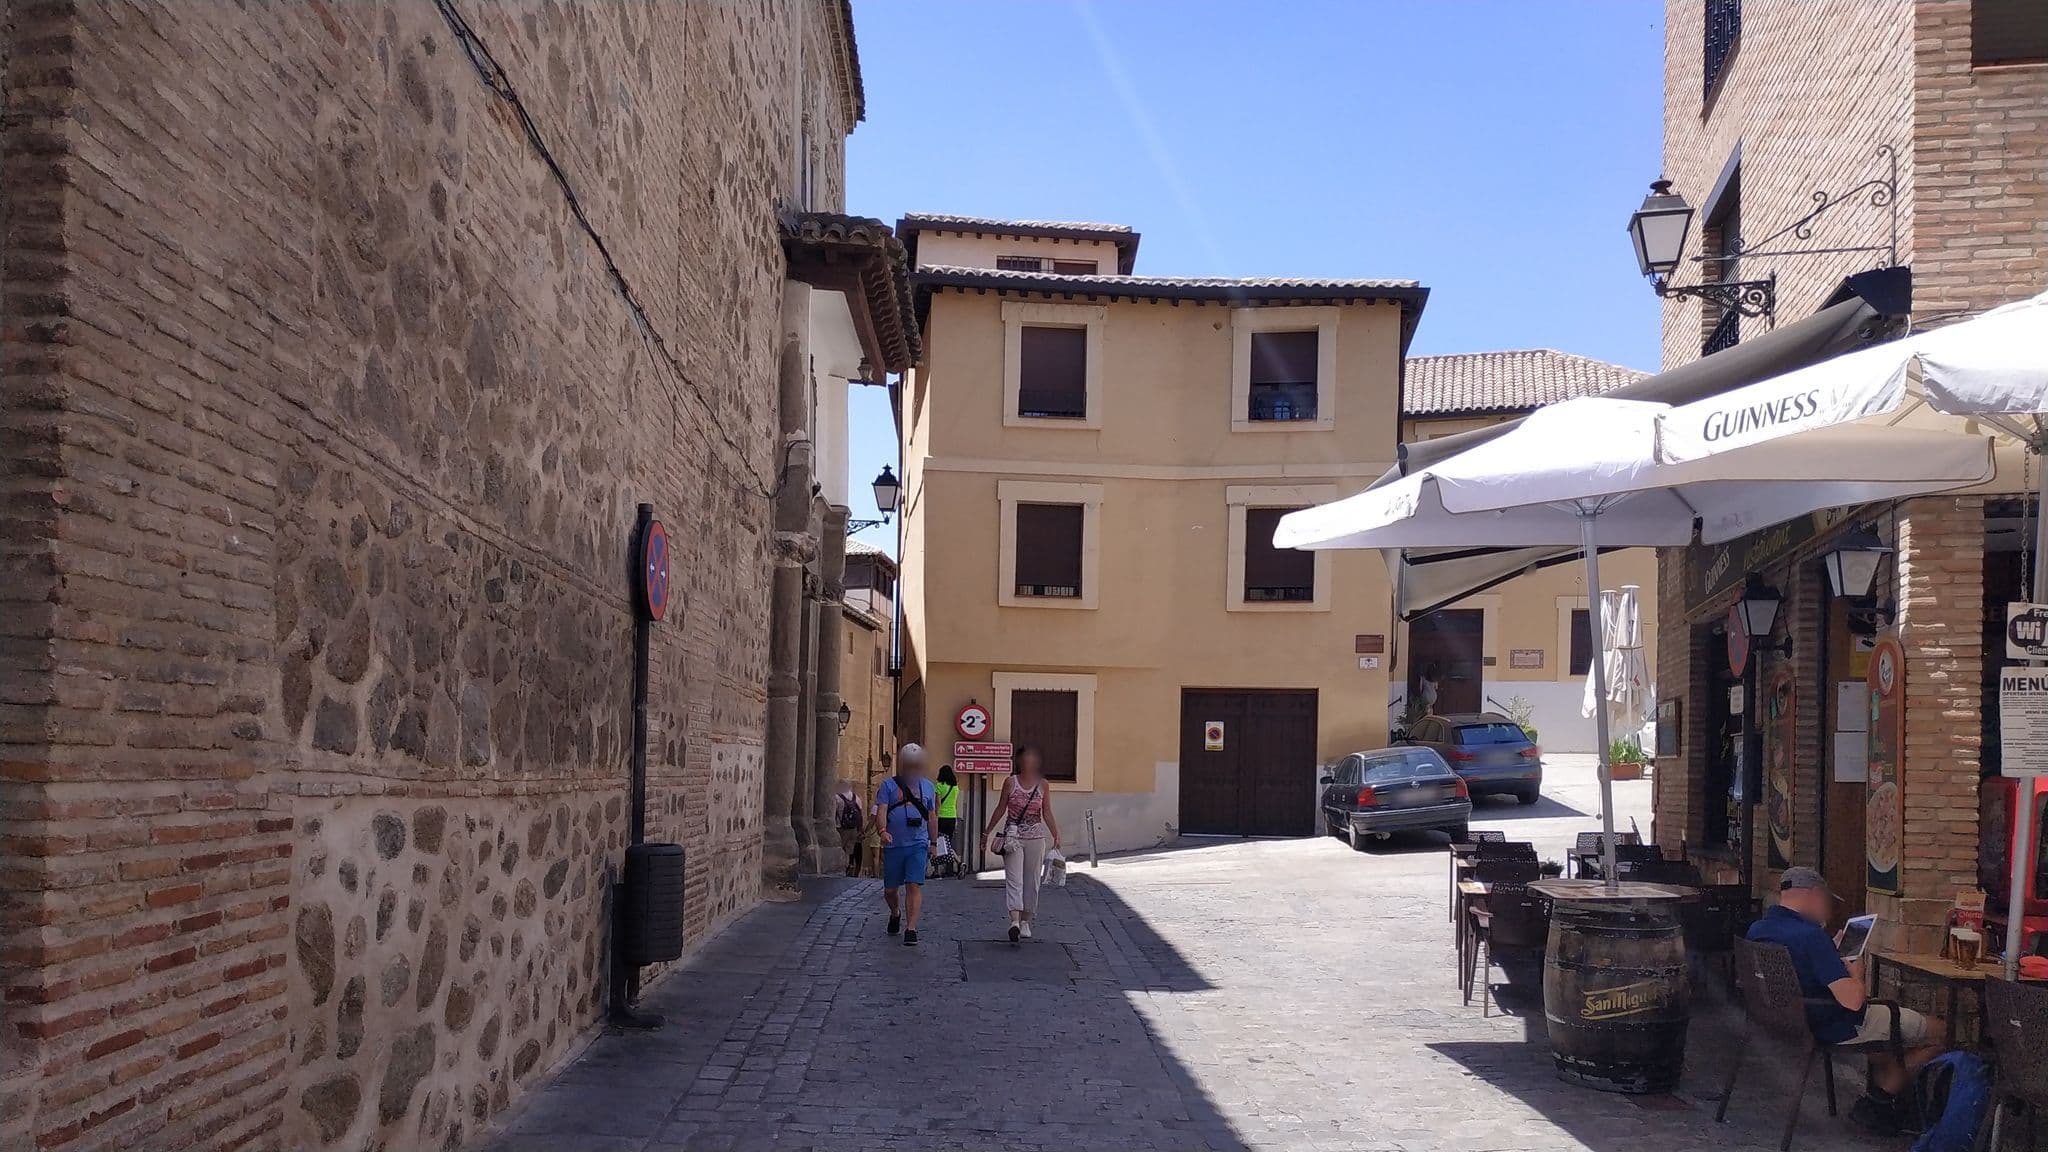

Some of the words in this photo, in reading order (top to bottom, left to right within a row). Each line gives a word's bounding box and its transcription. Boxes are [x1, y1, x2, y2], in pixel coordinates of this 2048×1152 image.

[1703, 389, 1819, 442] GUINNESS
[1704, 544, 1730, 595] GUINNESS
[2026, 645, 2048, 656] Clien
[2002, 673, 2048, 691] MENÚ
[1581, 995, 1612, 1015] San
